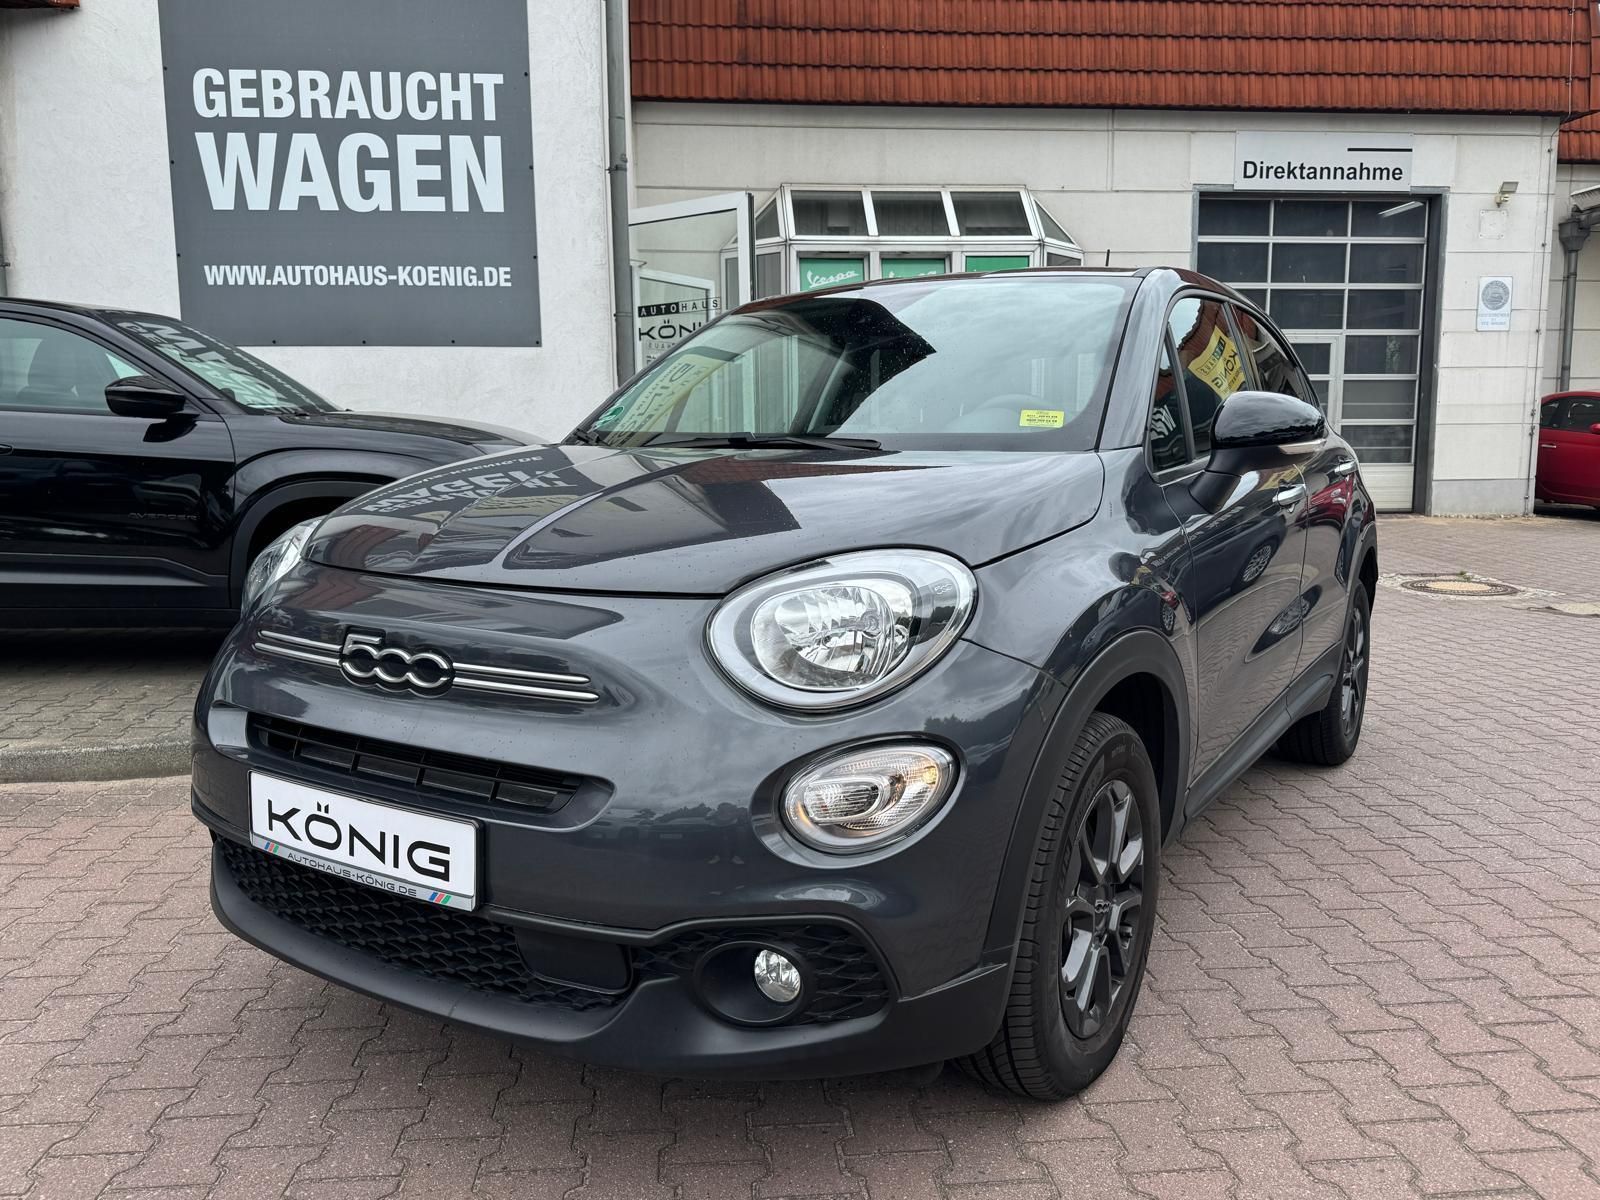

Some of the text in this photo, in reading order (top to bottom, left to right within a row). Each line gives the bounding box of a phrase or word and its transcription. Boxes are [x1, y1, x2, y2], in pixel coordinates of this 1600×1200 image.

[193, 68, 504, 121] GEBRAUCHT
[195, 131, 505, 213] WAGEN
[1242, 160, 1403, 181] Direktannahme
[203, 264, 512, 288] WWW.AUTOHAUS-KOENIG.DE
[807, 269, 859, 289] Vespa
[639, 299, 719, 317] AUTOHAUS
[342, 633, 451, 688] 500
[267, 798, 450, 882] KÖNIG
